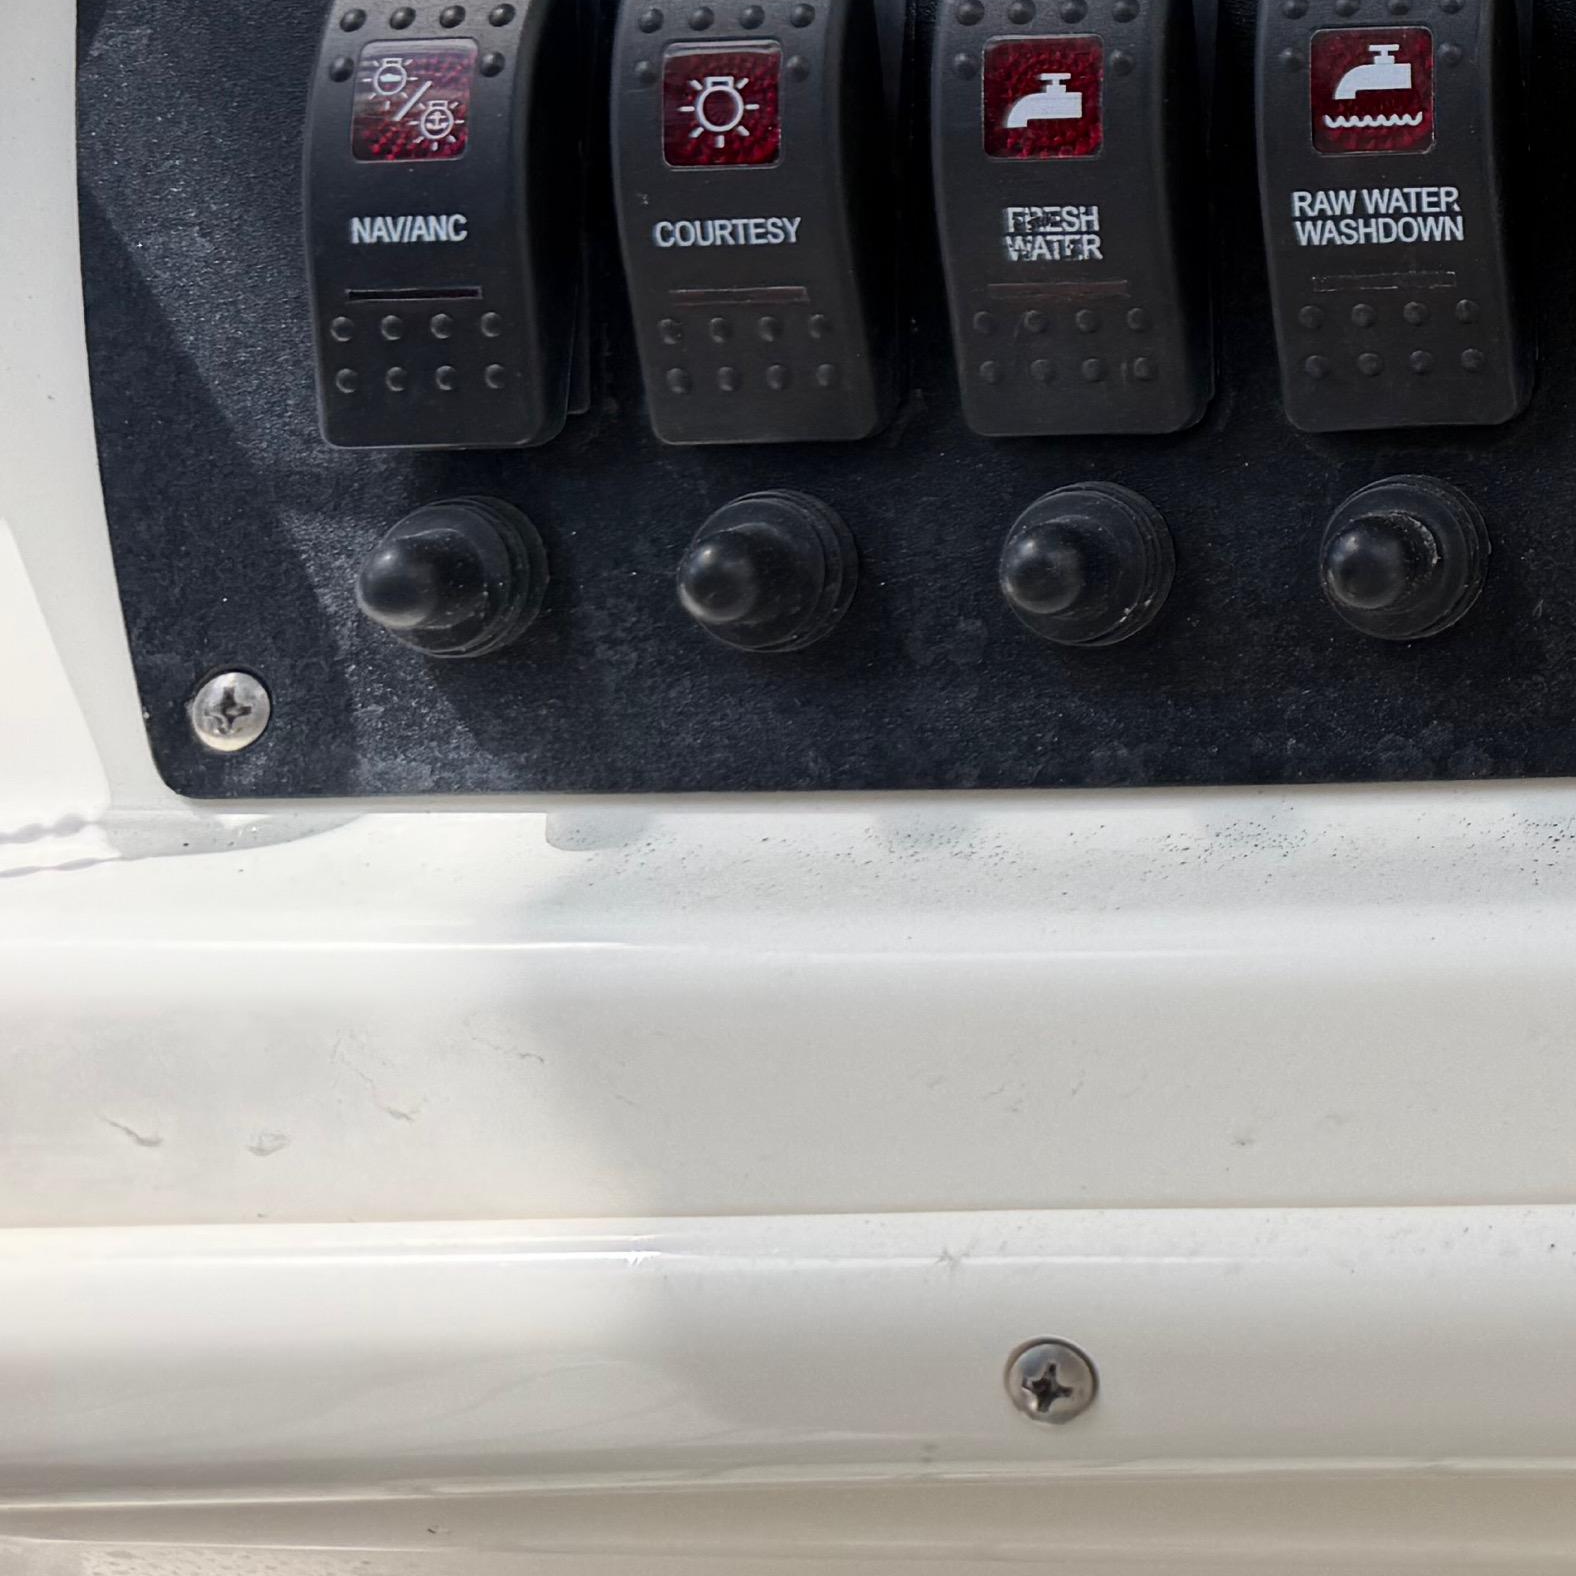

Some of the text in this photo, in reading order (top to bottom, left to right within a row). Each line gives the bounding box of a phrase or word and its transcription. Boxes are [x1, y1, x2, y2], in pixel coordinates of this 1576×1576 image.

[1292, 186, 1461, 218] RAW WATER
[351, 214, 468, 244] NAV/ANC
[655, 217, 801, 247] COURTESY
[1006, 205, 1100, 233] FRESH
[1294, 215, 1464, 246] WASHDOWN
[1005, 234, 1103, 261] WATER
